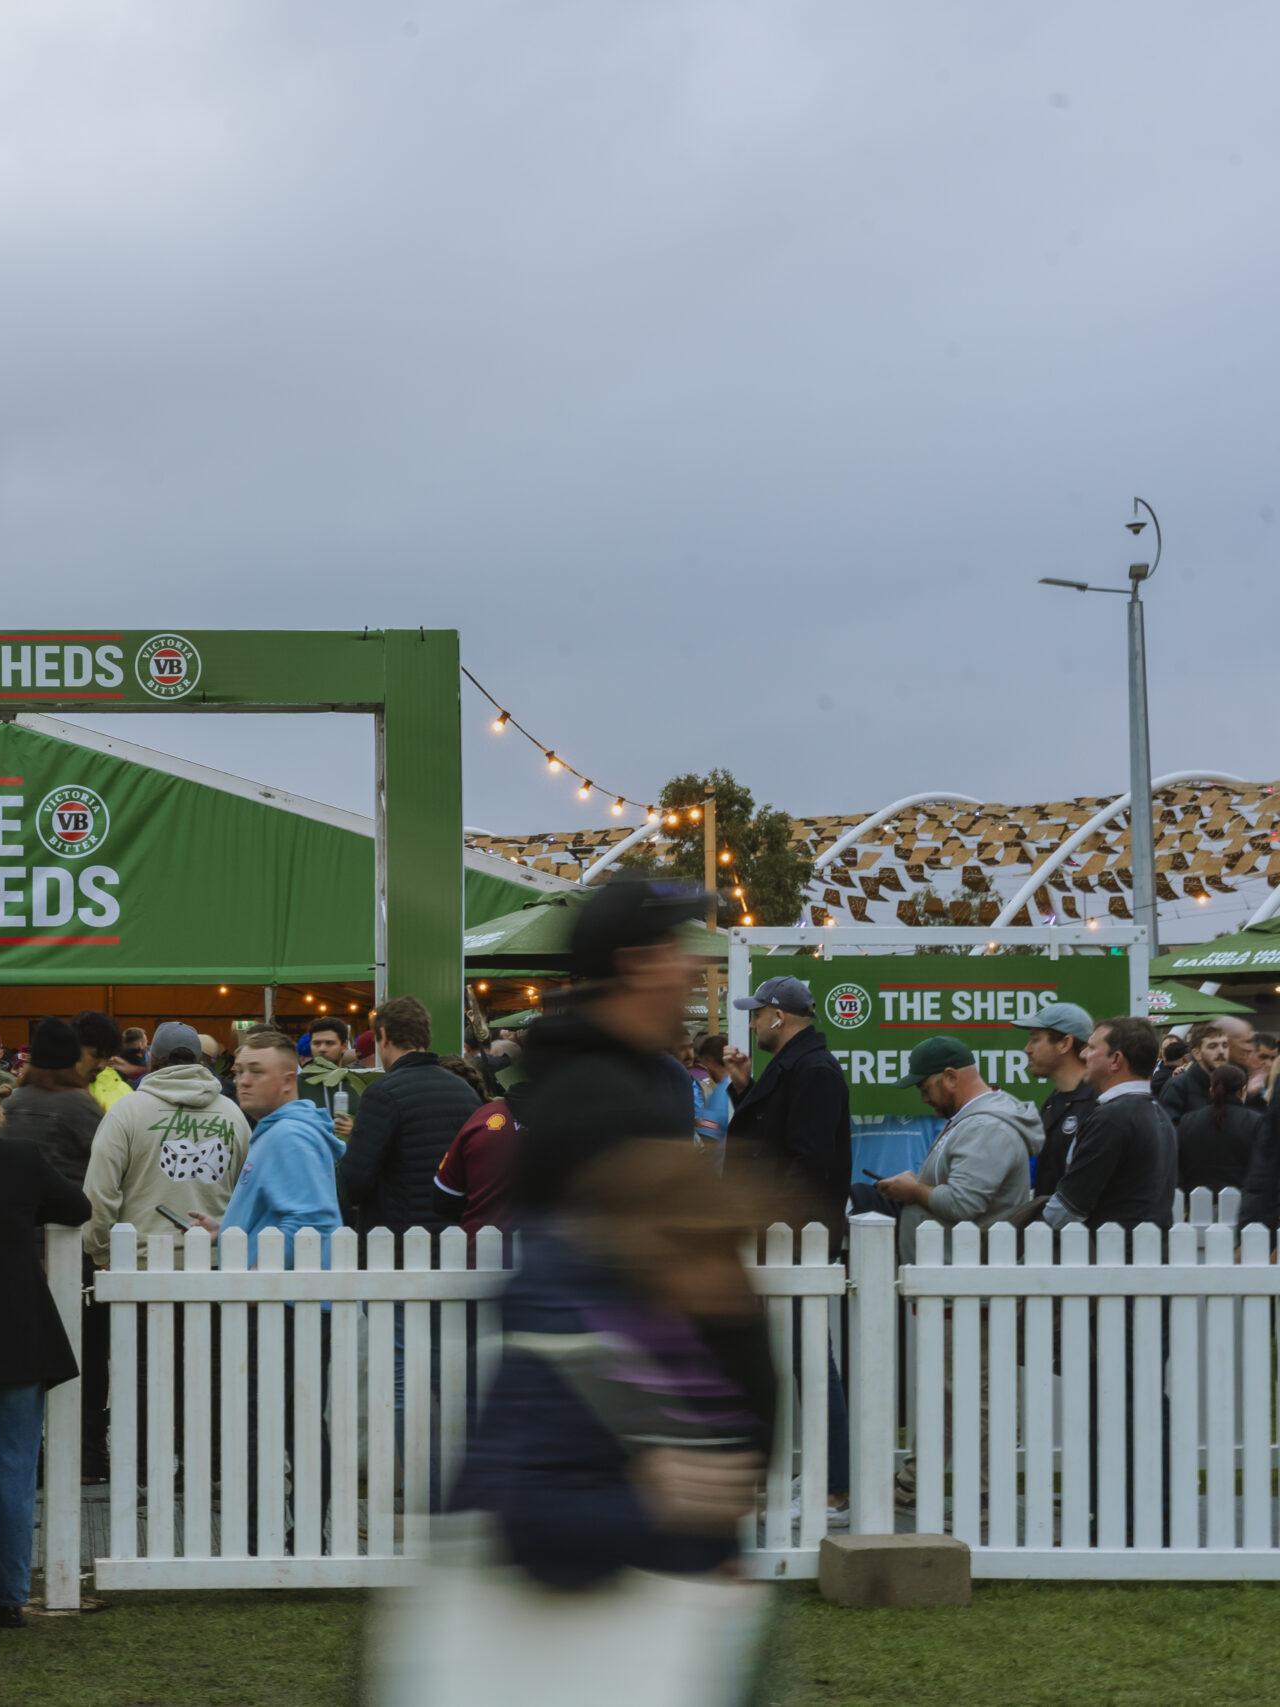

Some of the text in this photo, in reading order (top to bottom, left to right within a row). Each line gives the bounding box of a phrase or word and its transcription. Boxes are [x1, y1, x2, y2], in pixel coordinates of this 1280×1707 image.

[142, 638, 194, 660] VICTORIA
[154, 659, 183, 675] VB
[146, 678, 191, 695] BITTER
[44, 790, 101, 814] VICTORIA
[56, 812, 88, 831] VB
[49, 834, 99, 853] BITTER
[830, 987, 866, 1001] VICTORIA
[838, 1000, 858, 1012] VB
[878, 991, 942, 1021] THE
[833, 1014, 865, 1026] BITTER
